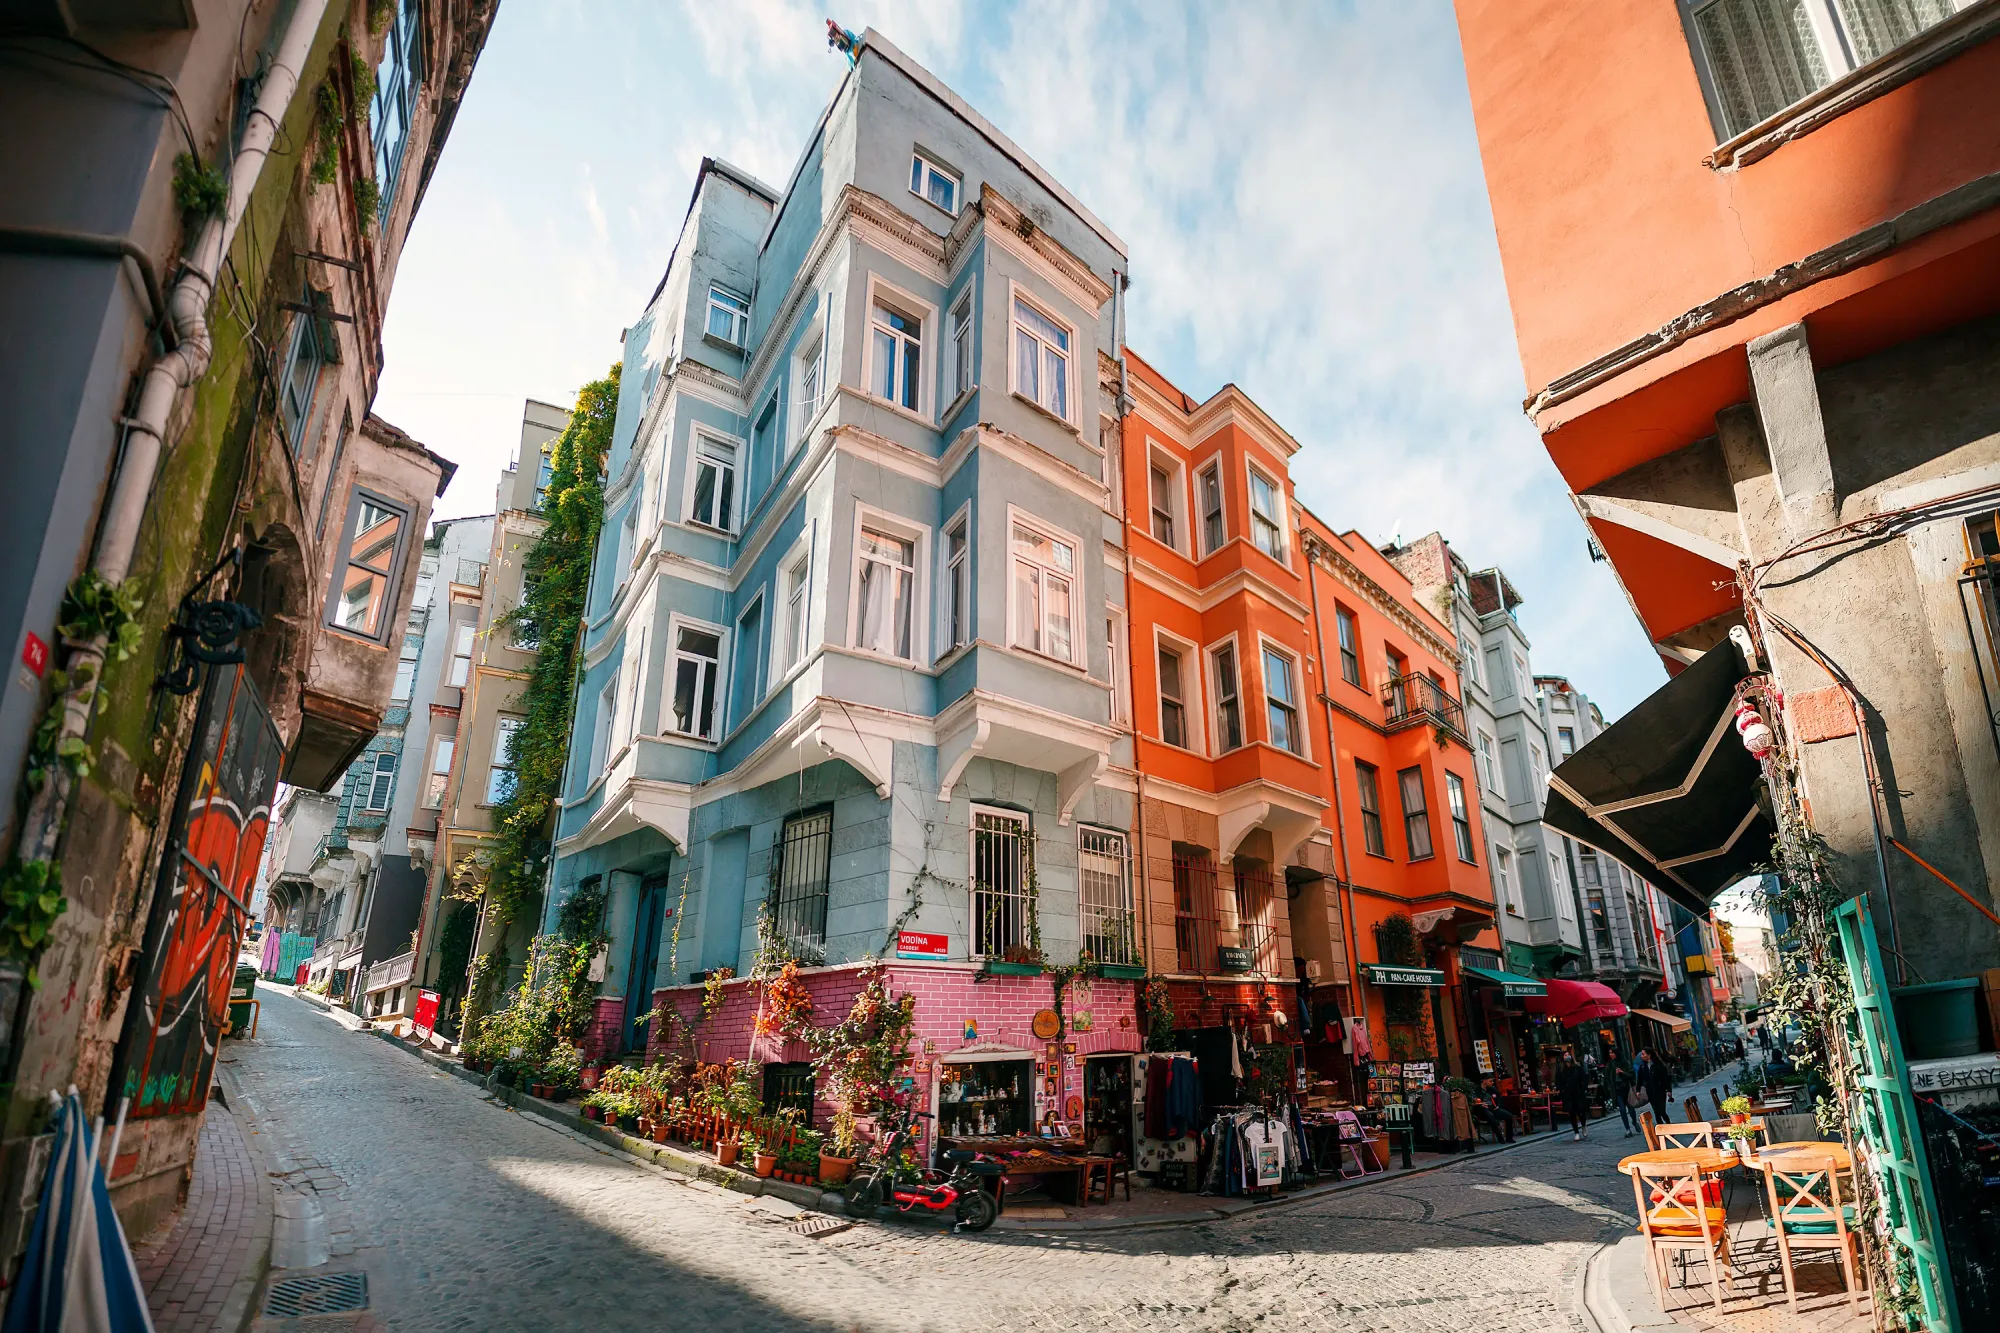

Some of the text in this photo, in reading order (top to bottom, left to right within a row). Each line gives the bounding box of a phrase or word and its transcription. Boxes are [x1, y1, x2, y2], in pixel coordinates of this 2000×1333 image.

[1375, 970, 1432, 983] PH PAN-CAKE HOUSE
[1917, 1073, 1935, 1087] NE
